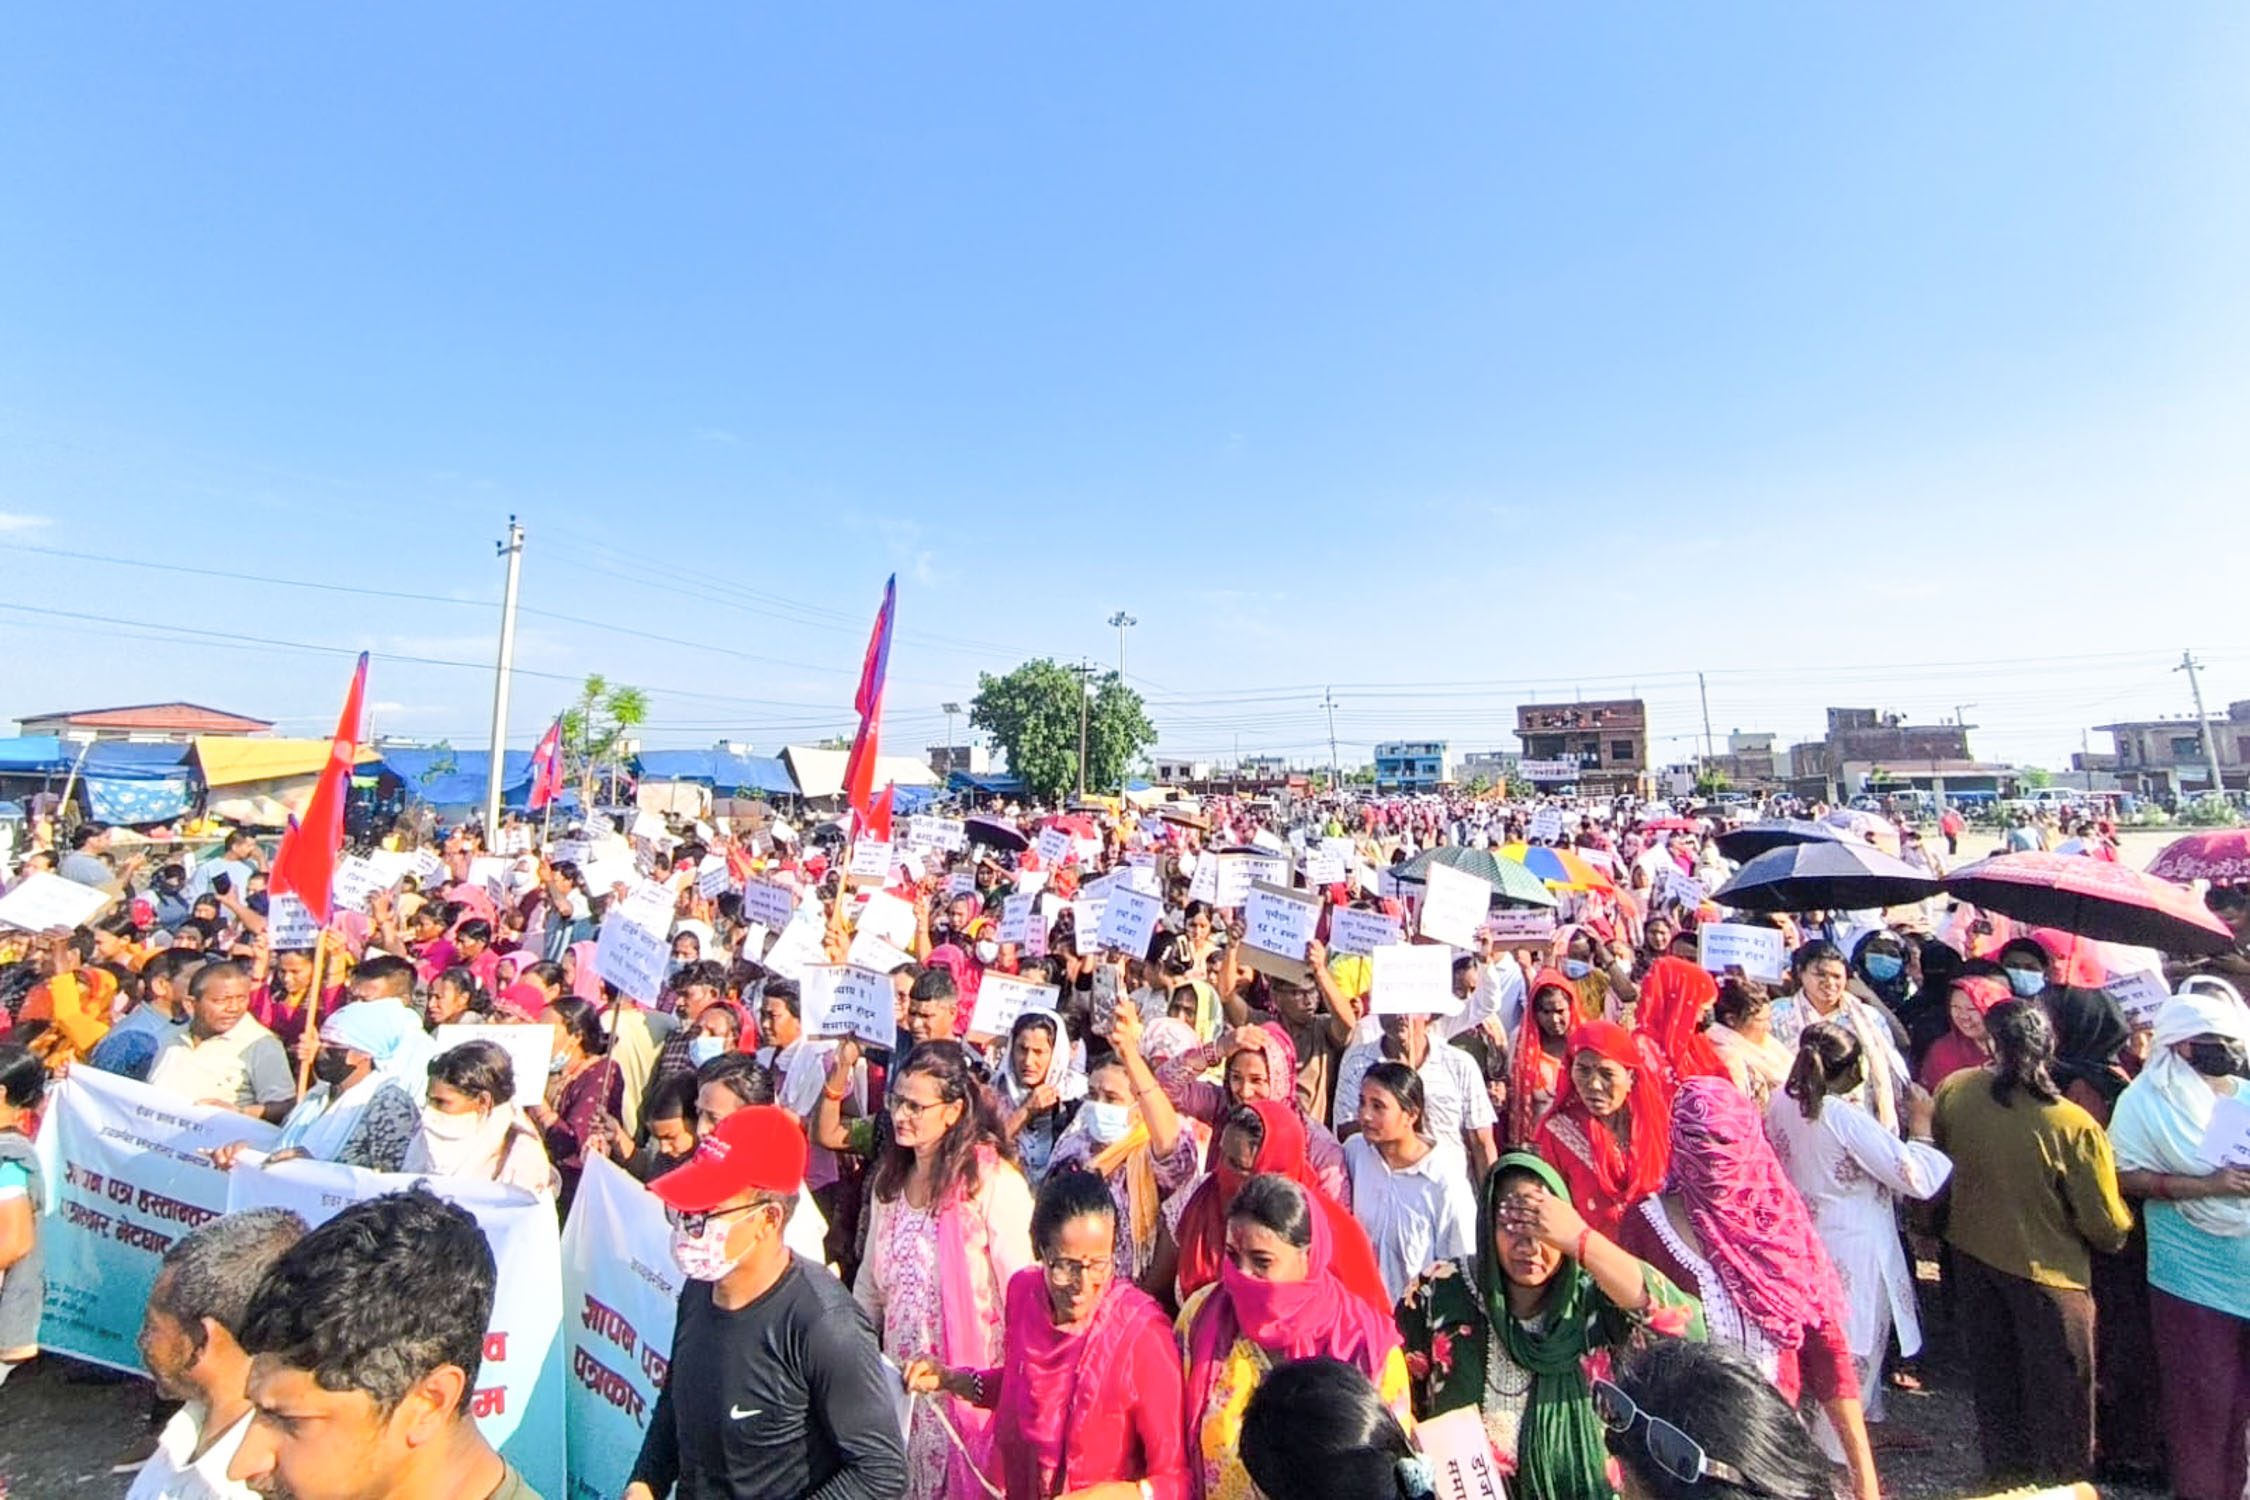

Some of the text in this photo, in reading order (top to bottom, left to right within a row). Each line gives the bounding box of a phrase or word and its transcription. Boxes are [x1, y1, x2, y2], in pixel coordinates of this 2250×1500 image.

[107, 1178, 135, 1206] पत्र
[138, 1188, 227, 1230] हस्तान्तर
[580, 1292, 638, 1359] ज्ञापन
[573, 1343, 647, 1430] पत्रकार
[1447, 1458, 1468, 1500] समा
[1471, 1452, 1497, 1500] डोज
